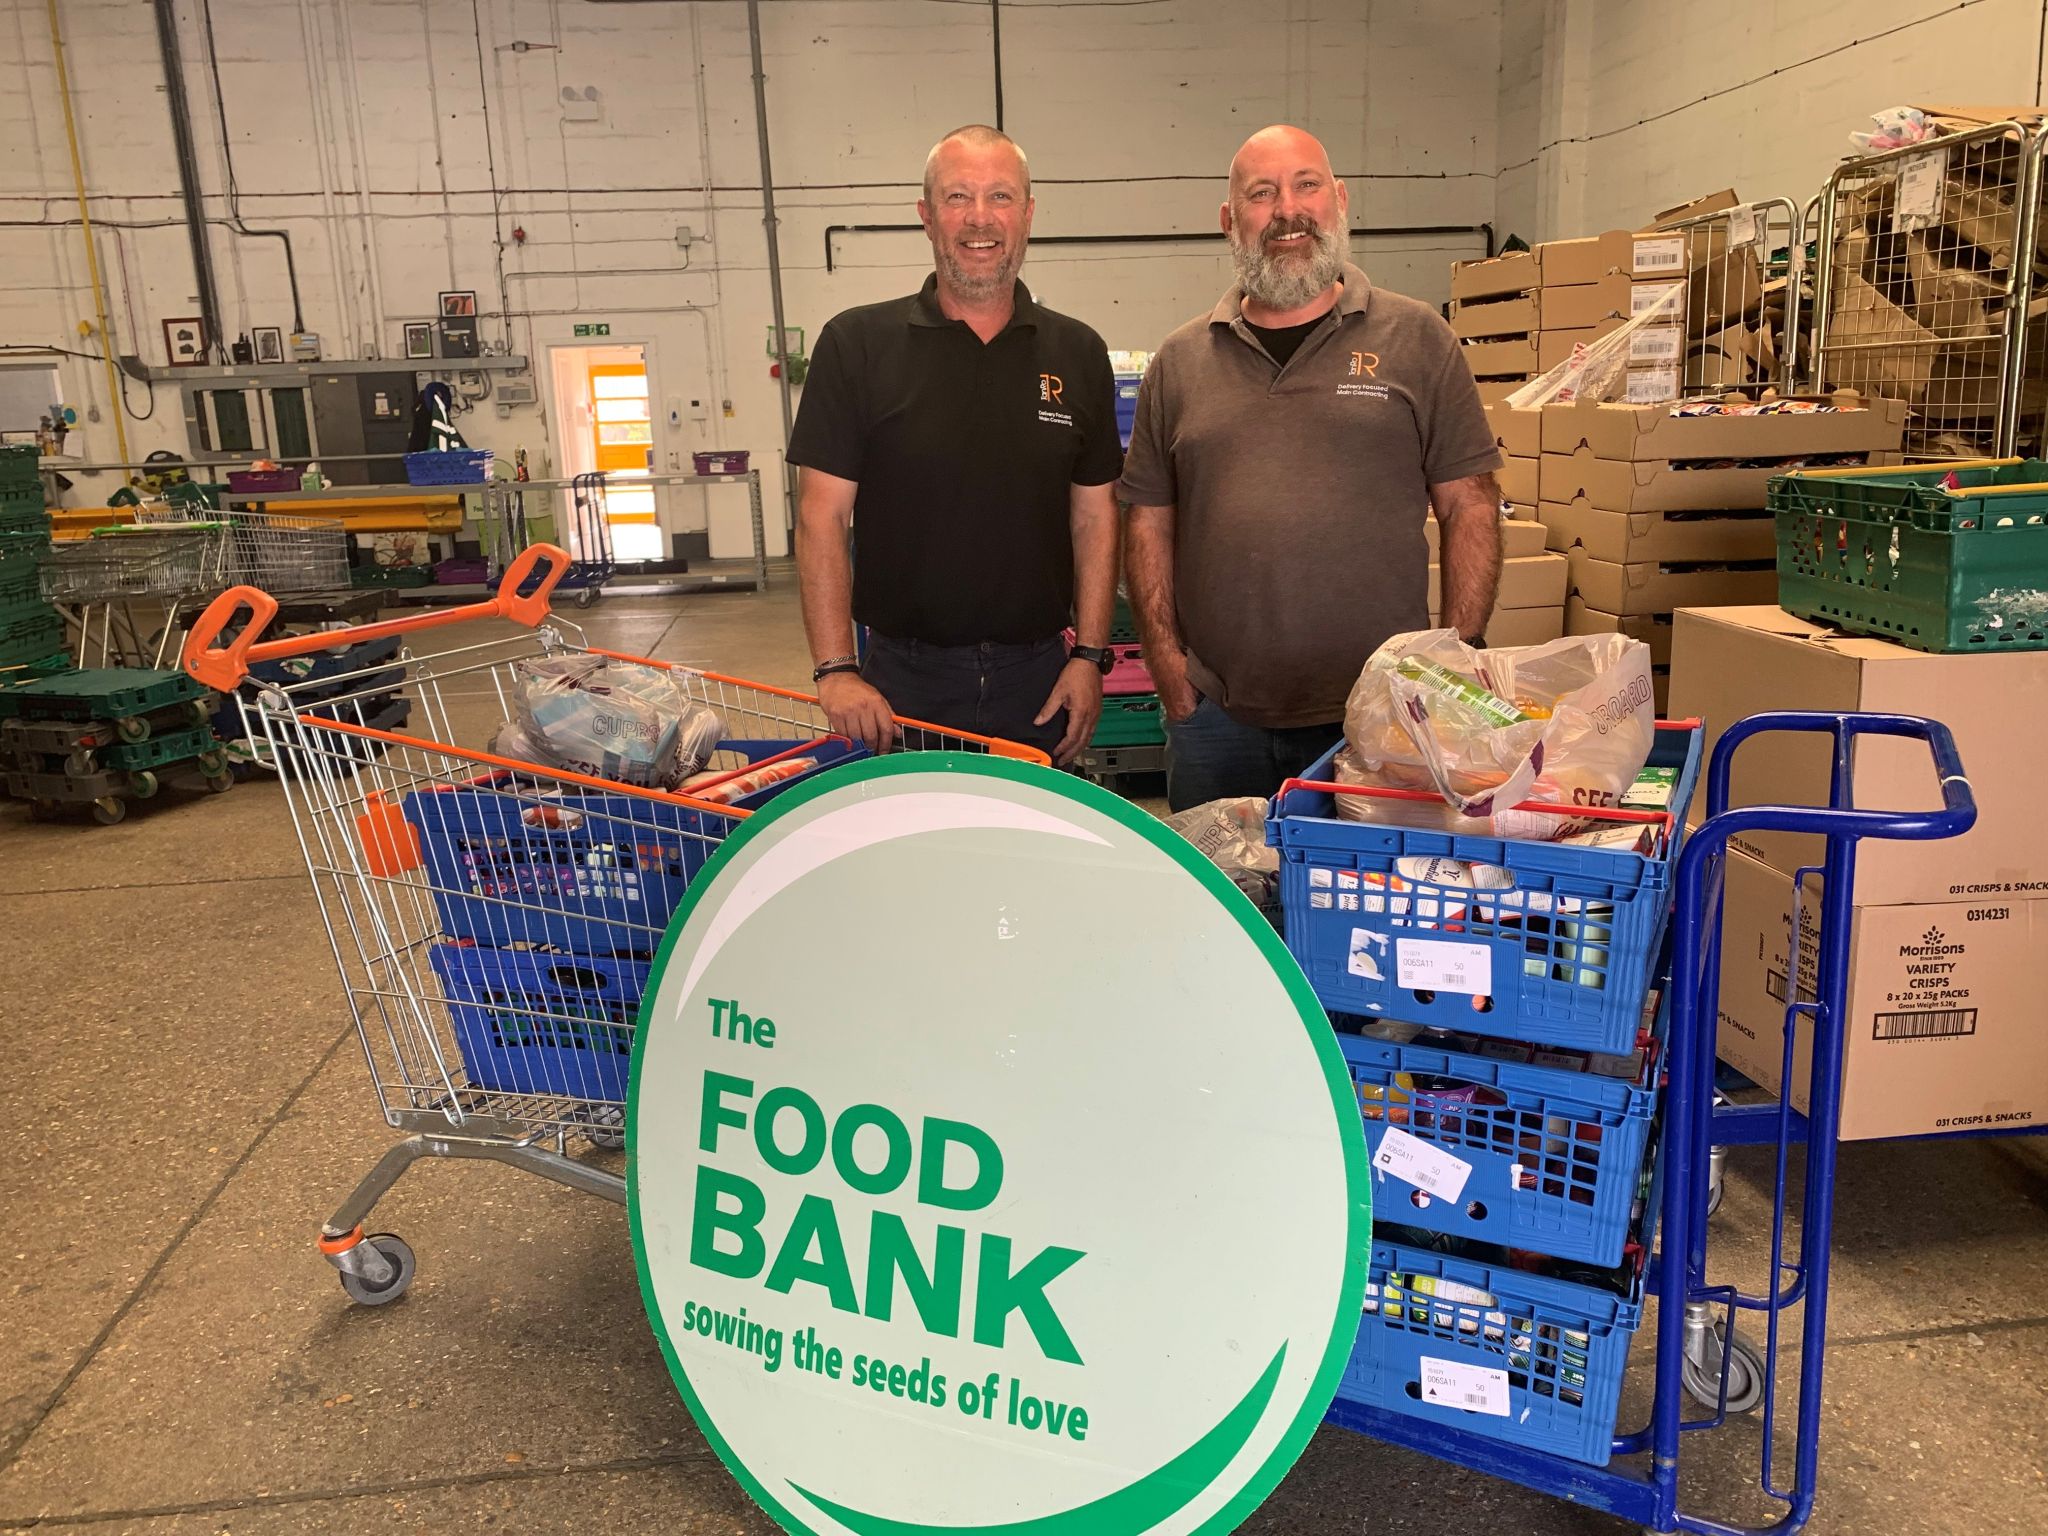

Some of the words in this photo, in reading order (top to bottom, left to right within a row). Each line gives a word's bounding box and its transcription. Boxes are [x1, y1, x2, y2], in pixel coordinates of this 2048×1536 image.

[1362, 384, 1388, 392] Focused
[1352, 390, 1388, 400] Contracting
[1744, 841, 1765, 859] SNACKS
[1949, 885, 1965, 894] 031
[1966, 883, 2001, 893] CRISPS
[2003, 882, 2011, 892] &
[2014, 881, 2048, 891] SNACK
[1966, 908, 2010, 922] 0314231
[1899, 943, 1965, 957] Morrisons
[1454, 962, 1464, 971] 50
[1906, 962, 1956, 975] VARIETY
[1909, 977, 1950, 988] CRISPS
[1886, 992, 1892, 1001] 8
[1902, 992, 1913, 1000] 20
[1923, 991, 1938, 1001] 25g
[1940, 989, 1969, 999] PACKS
[1916, 1001, 1940, 1010] Weight
[708, 999, 776, 1048] The
[1732, 1017, 1755, 1040] SNACKS
[1935, 1118, 1950, 1127] 031
[1952, 1115, 1983, 1126] CRISPS
[1985, 1115, 1993, 1123] &
[1994, 1111, 2032, 1122] SNACKS
[699, 1071, 1004, 1211] FOOD
[1431, 1166, 1440, 1176] 50
[690, 1165, 1086, 1365] BANK
[684, 1301, 783, 1372] sowing
[792, 1328, 843, 1380] the
[852, 1354, 946, 1408] seeds
[957, 1373, 1000, 1419] of
[1008, 1379, 1088, 1441] love
[1475, 1383, 1485, 1392] 50
